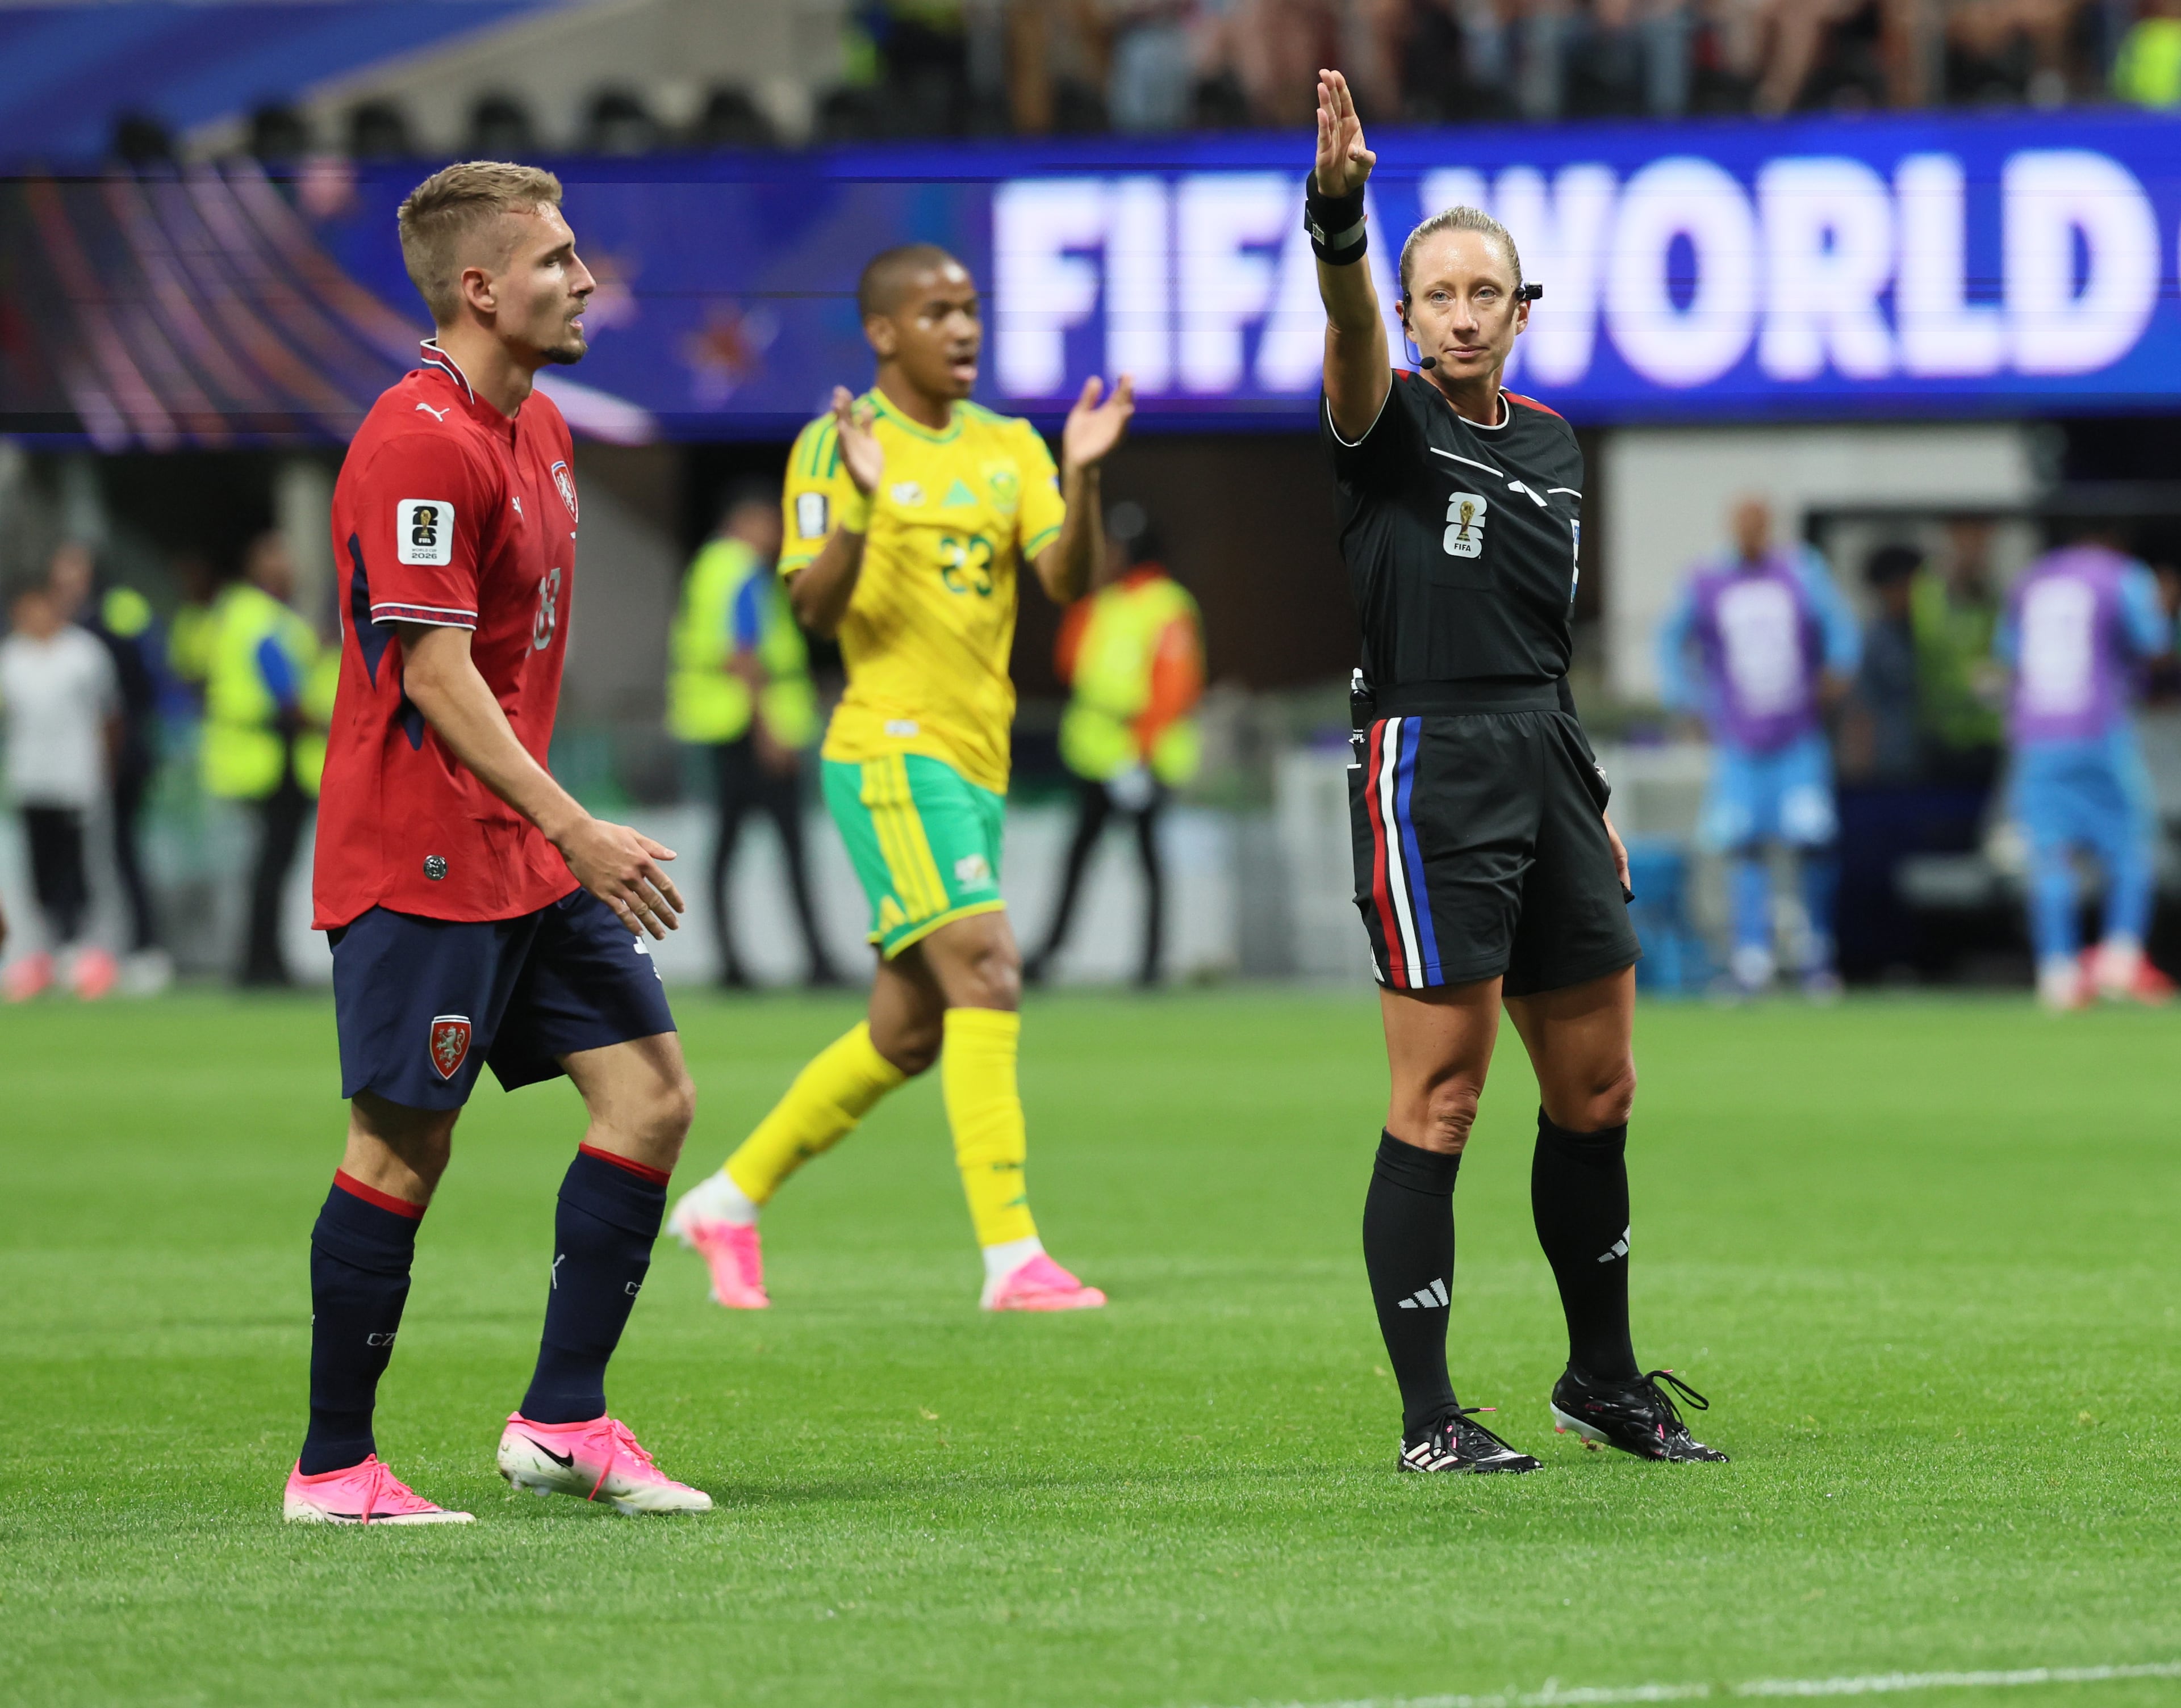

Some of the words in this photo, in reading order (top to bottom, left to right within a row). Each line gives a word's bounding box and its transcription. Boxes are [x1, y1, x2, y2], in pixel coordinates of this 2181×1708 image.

[1418, 149, 2161, 392] WORLD
[940, 534, 994, 597] 23
[1454, 543, 1471, 551] FIFA
